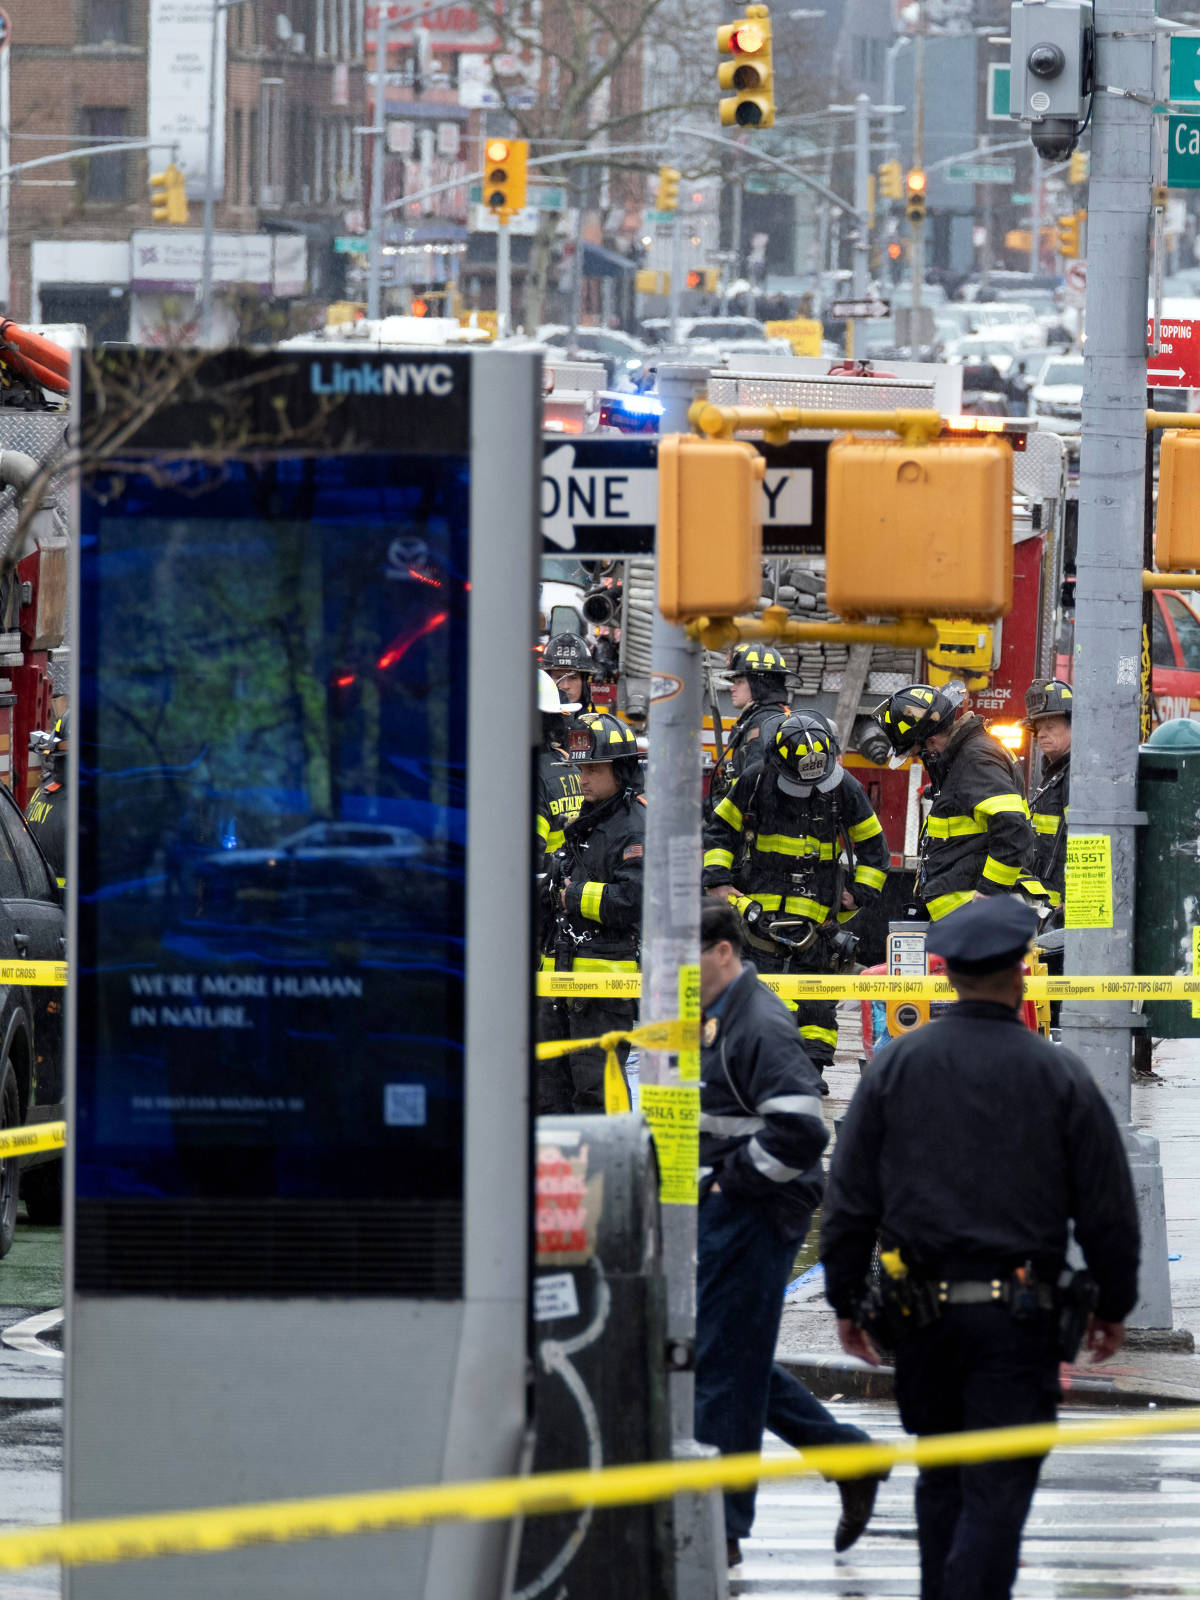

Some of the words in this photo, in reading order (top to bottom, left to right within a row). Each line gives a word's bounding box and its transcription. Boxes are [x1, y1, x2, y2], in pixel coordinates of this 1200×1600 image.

[1159, 325, 1192, 339] TOPPING
[310, 363, 454, 397] LinkNYC
[542, 475, 630, 519] ONE
[976, 700, 1006, 709] FEET
[802, 760, 823, 771] 228
[1081, 852, 1105, 863] SST
[1, 967, 14, 978] NOT
[15, 968, 37, 979] CROSS
[202, 975, 267, 996] MORE
[272, 975, 363, 997] HUMAN
[568, 981, 599, 991] stoppers
[605, 979, 641, 990] 1-800-577-
[816, 984, 847, 993] stoppers
[852, 983, 902, 993] 1-800-577-TIPS
[903, 982, 924, 993] (8477)
[1064, 984, 1095, 994] stoppers
[1101, 982, 1151, 993] 1-800-577-TIPS
[1152, 982, 1173, 994] (8477)
[130, 1006, 157, 1027] IN
